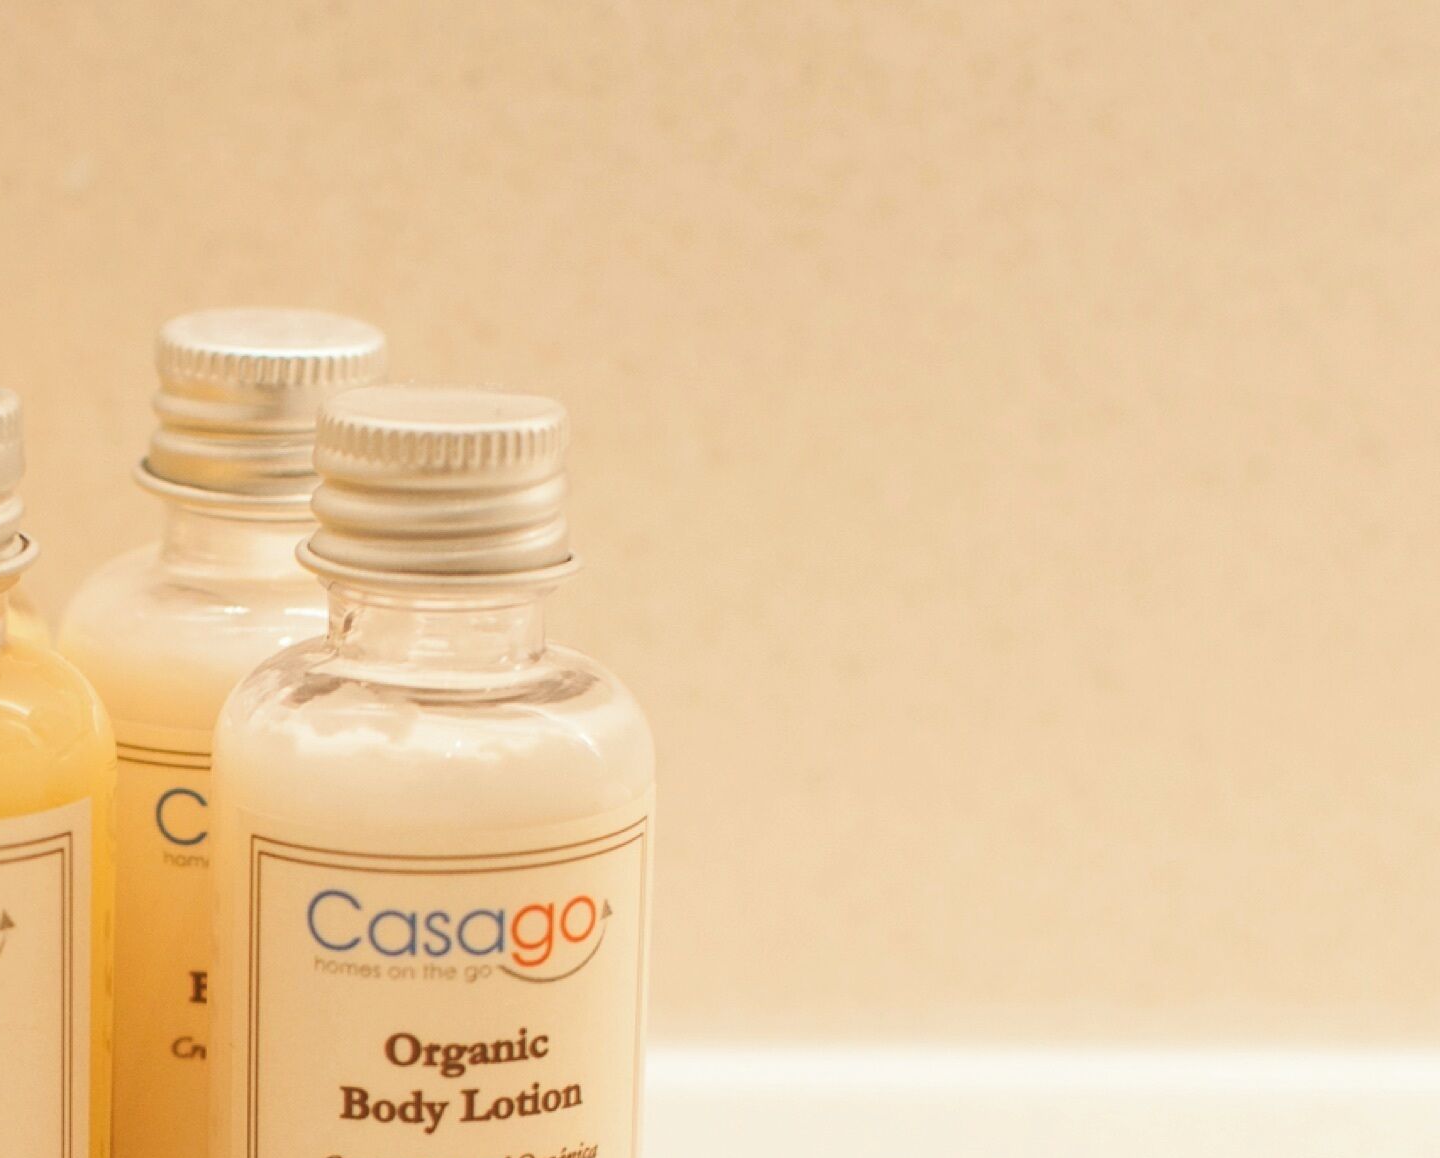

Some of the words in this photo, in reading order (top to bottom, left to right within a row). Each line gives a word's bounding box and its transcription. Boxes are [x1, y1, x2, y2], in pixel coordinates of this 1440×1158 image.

[307, 889, 597, 968] Casago
[314, 955, 381, 979] homes
[387, 963, 415, 981] on
[422, 962, 457, 980] the
[464, 964, 493, 984] go
[384, 1027, 550, 1079] Organic
[339, 1085, 450, 1135] Body
[460, 1081, 584, 1123] Lotion
